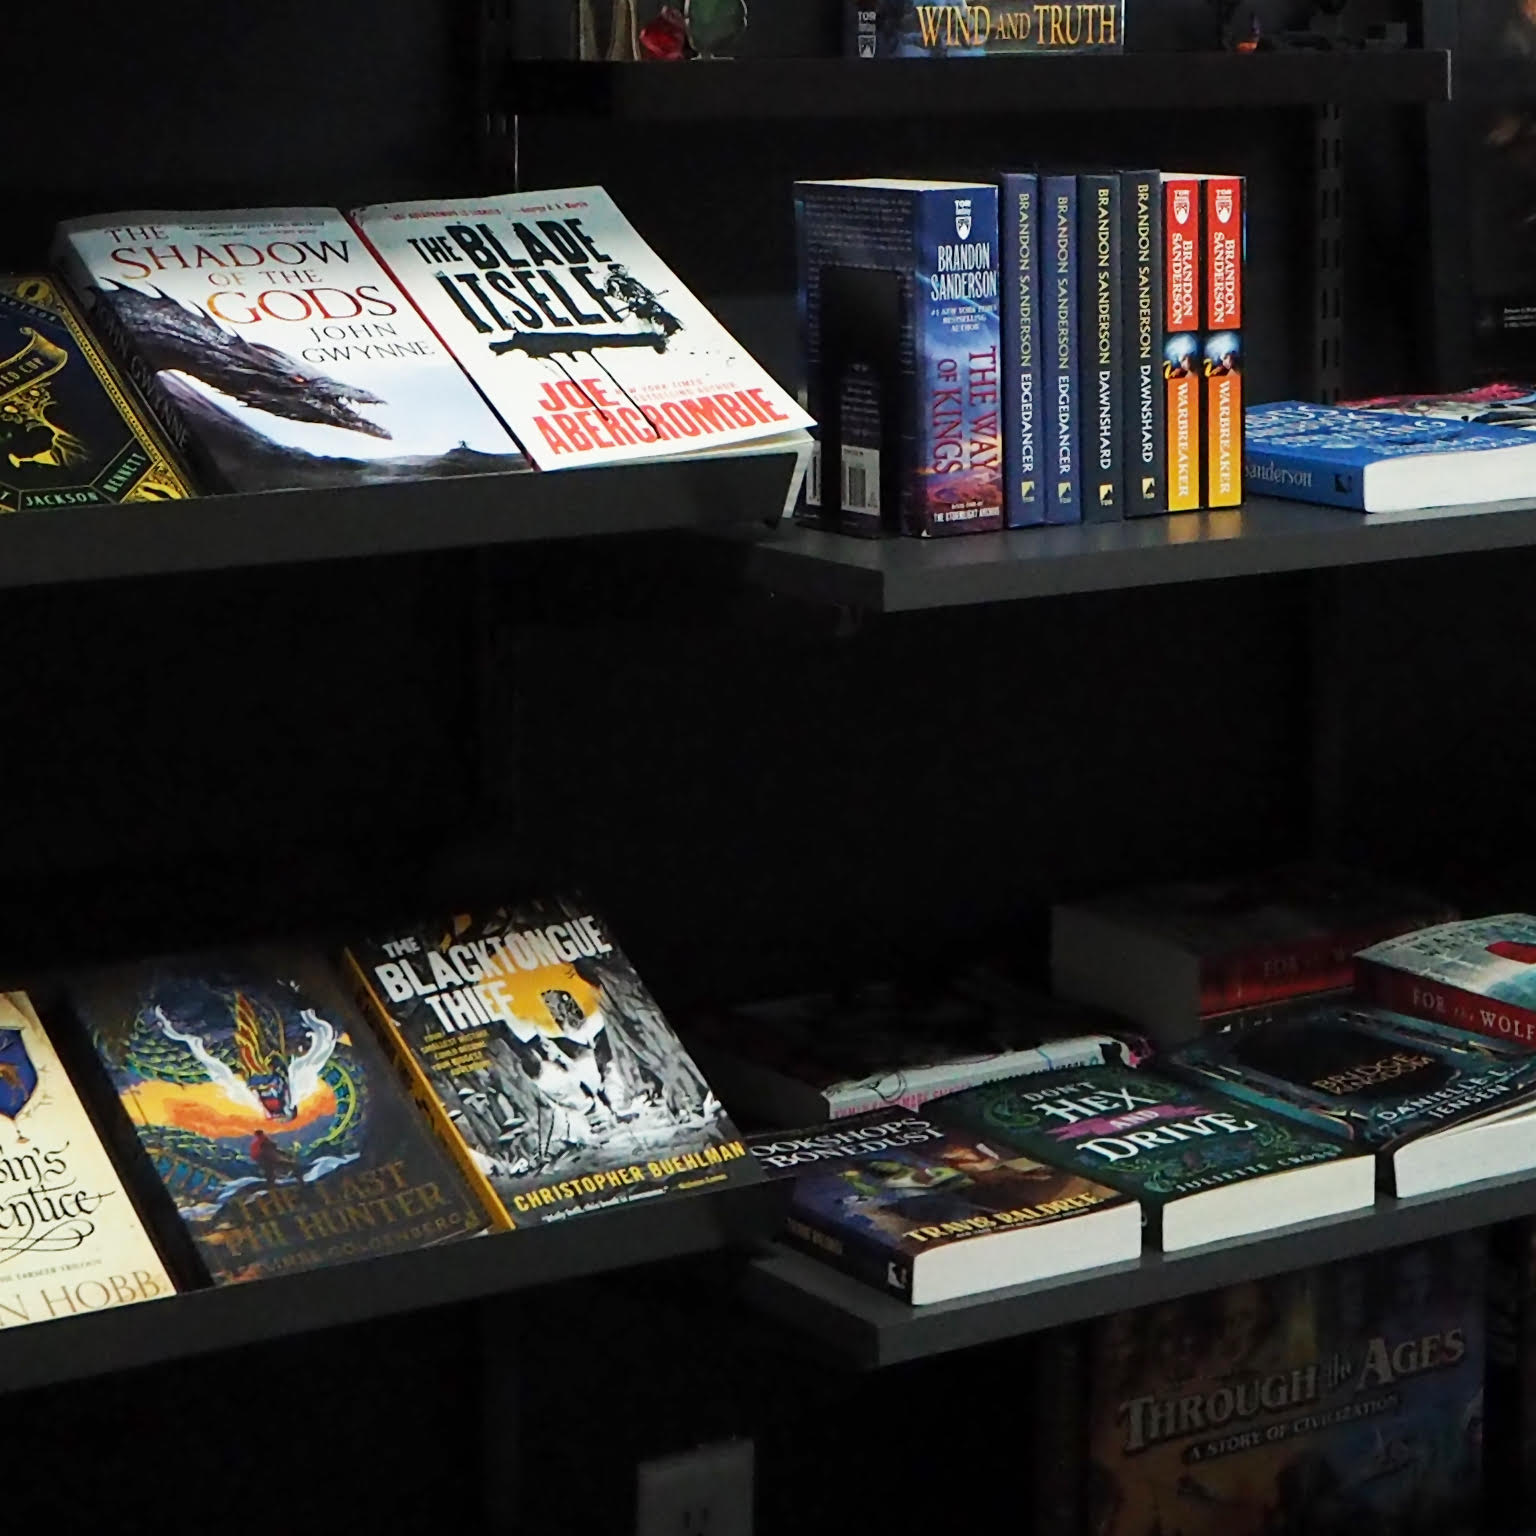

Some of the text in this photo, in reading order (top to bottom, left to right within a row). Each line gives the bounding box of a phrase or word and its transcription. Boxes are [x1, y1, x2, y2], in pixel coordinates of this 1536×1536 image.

[917, 3, 1117, 47] WIND AND TRUTH
[109, 226, 169, 243] THE
[407, 218, 613, 270] THE BLADE
[111, 240, 350, 279] SHADOW
[207, 269, 324, 287] OF THE
[207, 285, 398, 324] GODS
[433, 266, 629, 334] ITSELF
[302, 341, 435, 364] GWYNNE
[309, 322, 397, 343] JOHN
[23, 357, 46, 375] CUP
[537, 378, 620, 412] JOE
[532, 388, 790, 455] ABERCROMBIE
[1021, 374, 1033, 473] EDGEDANCER
[1099, 371, 1111, 470] DAWNSHARD
[1177, 382, 1189, 497] WARBREAKER
[25, 491, 99, 507] JACKSON
[103, 452, 147, 493] BENNETT
[375, 915, 613, 1003] BLACKTONGUE
[383, 937, 420, 958] THE
[424, 980, 514, 1033] THIEF
[1021, 1081, 1097, 1103] DON'T
[1032, 1088, 1161, 1124] HEX
[1076, 1112, 1258, 1162] DRIVE
[1109, 1109, 1159, 1130] AND
[514, 1142, 746, 1212] CHRISTOPHER BUEHLMAN
[41, 1270, 161, 1317] HOBB
[1120, 1328, 1465, 1451] THROUGH AGES
